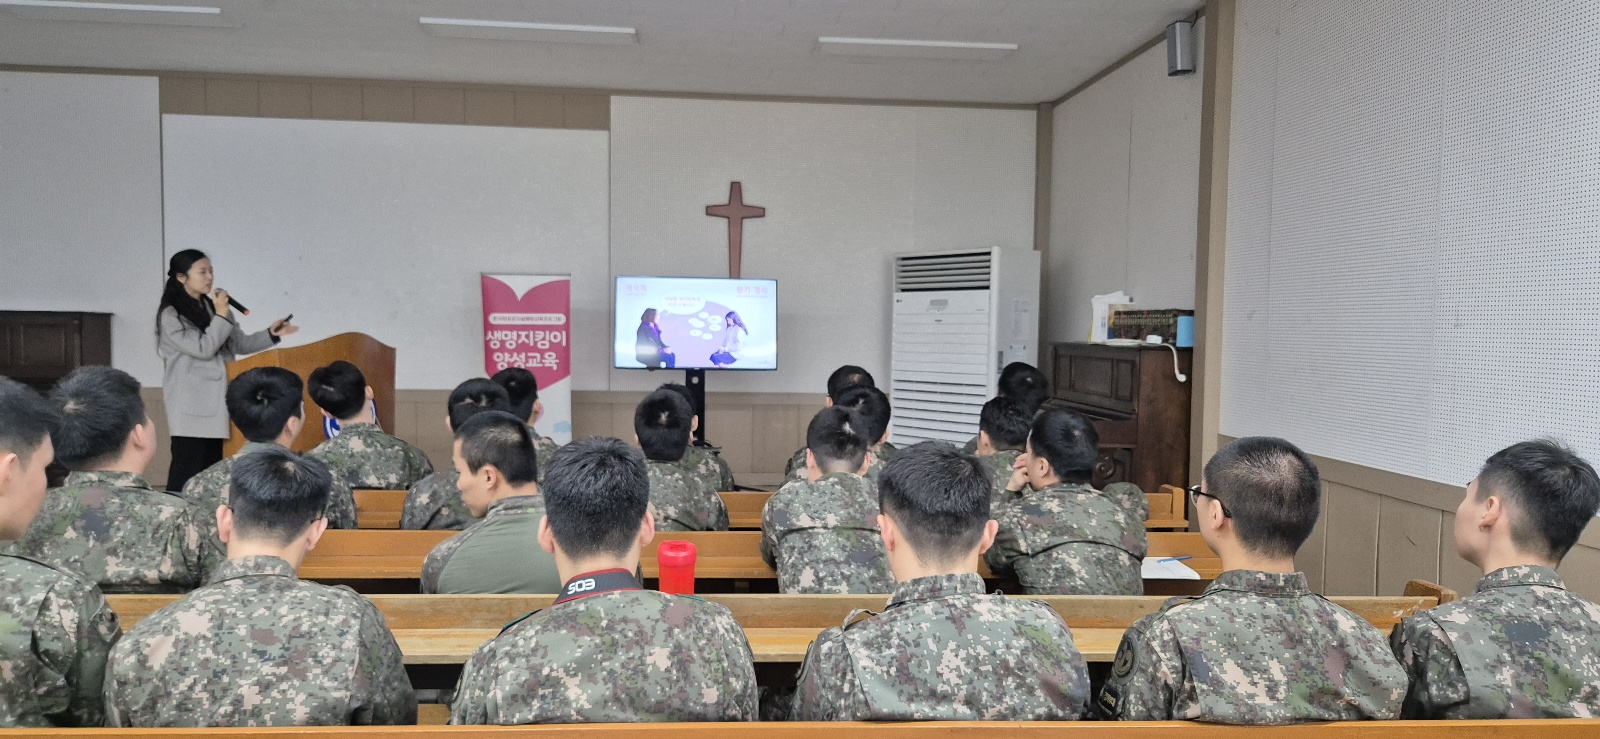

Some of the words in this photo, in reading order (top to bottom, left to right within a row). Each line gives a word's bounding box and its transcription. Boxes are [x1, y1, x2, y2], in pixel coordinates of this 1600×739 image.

[486, 330, 567, 350] 생명지킴이
[493, 351, 560, 371] 양성교육
[567, 579, 596, 595] EOS
